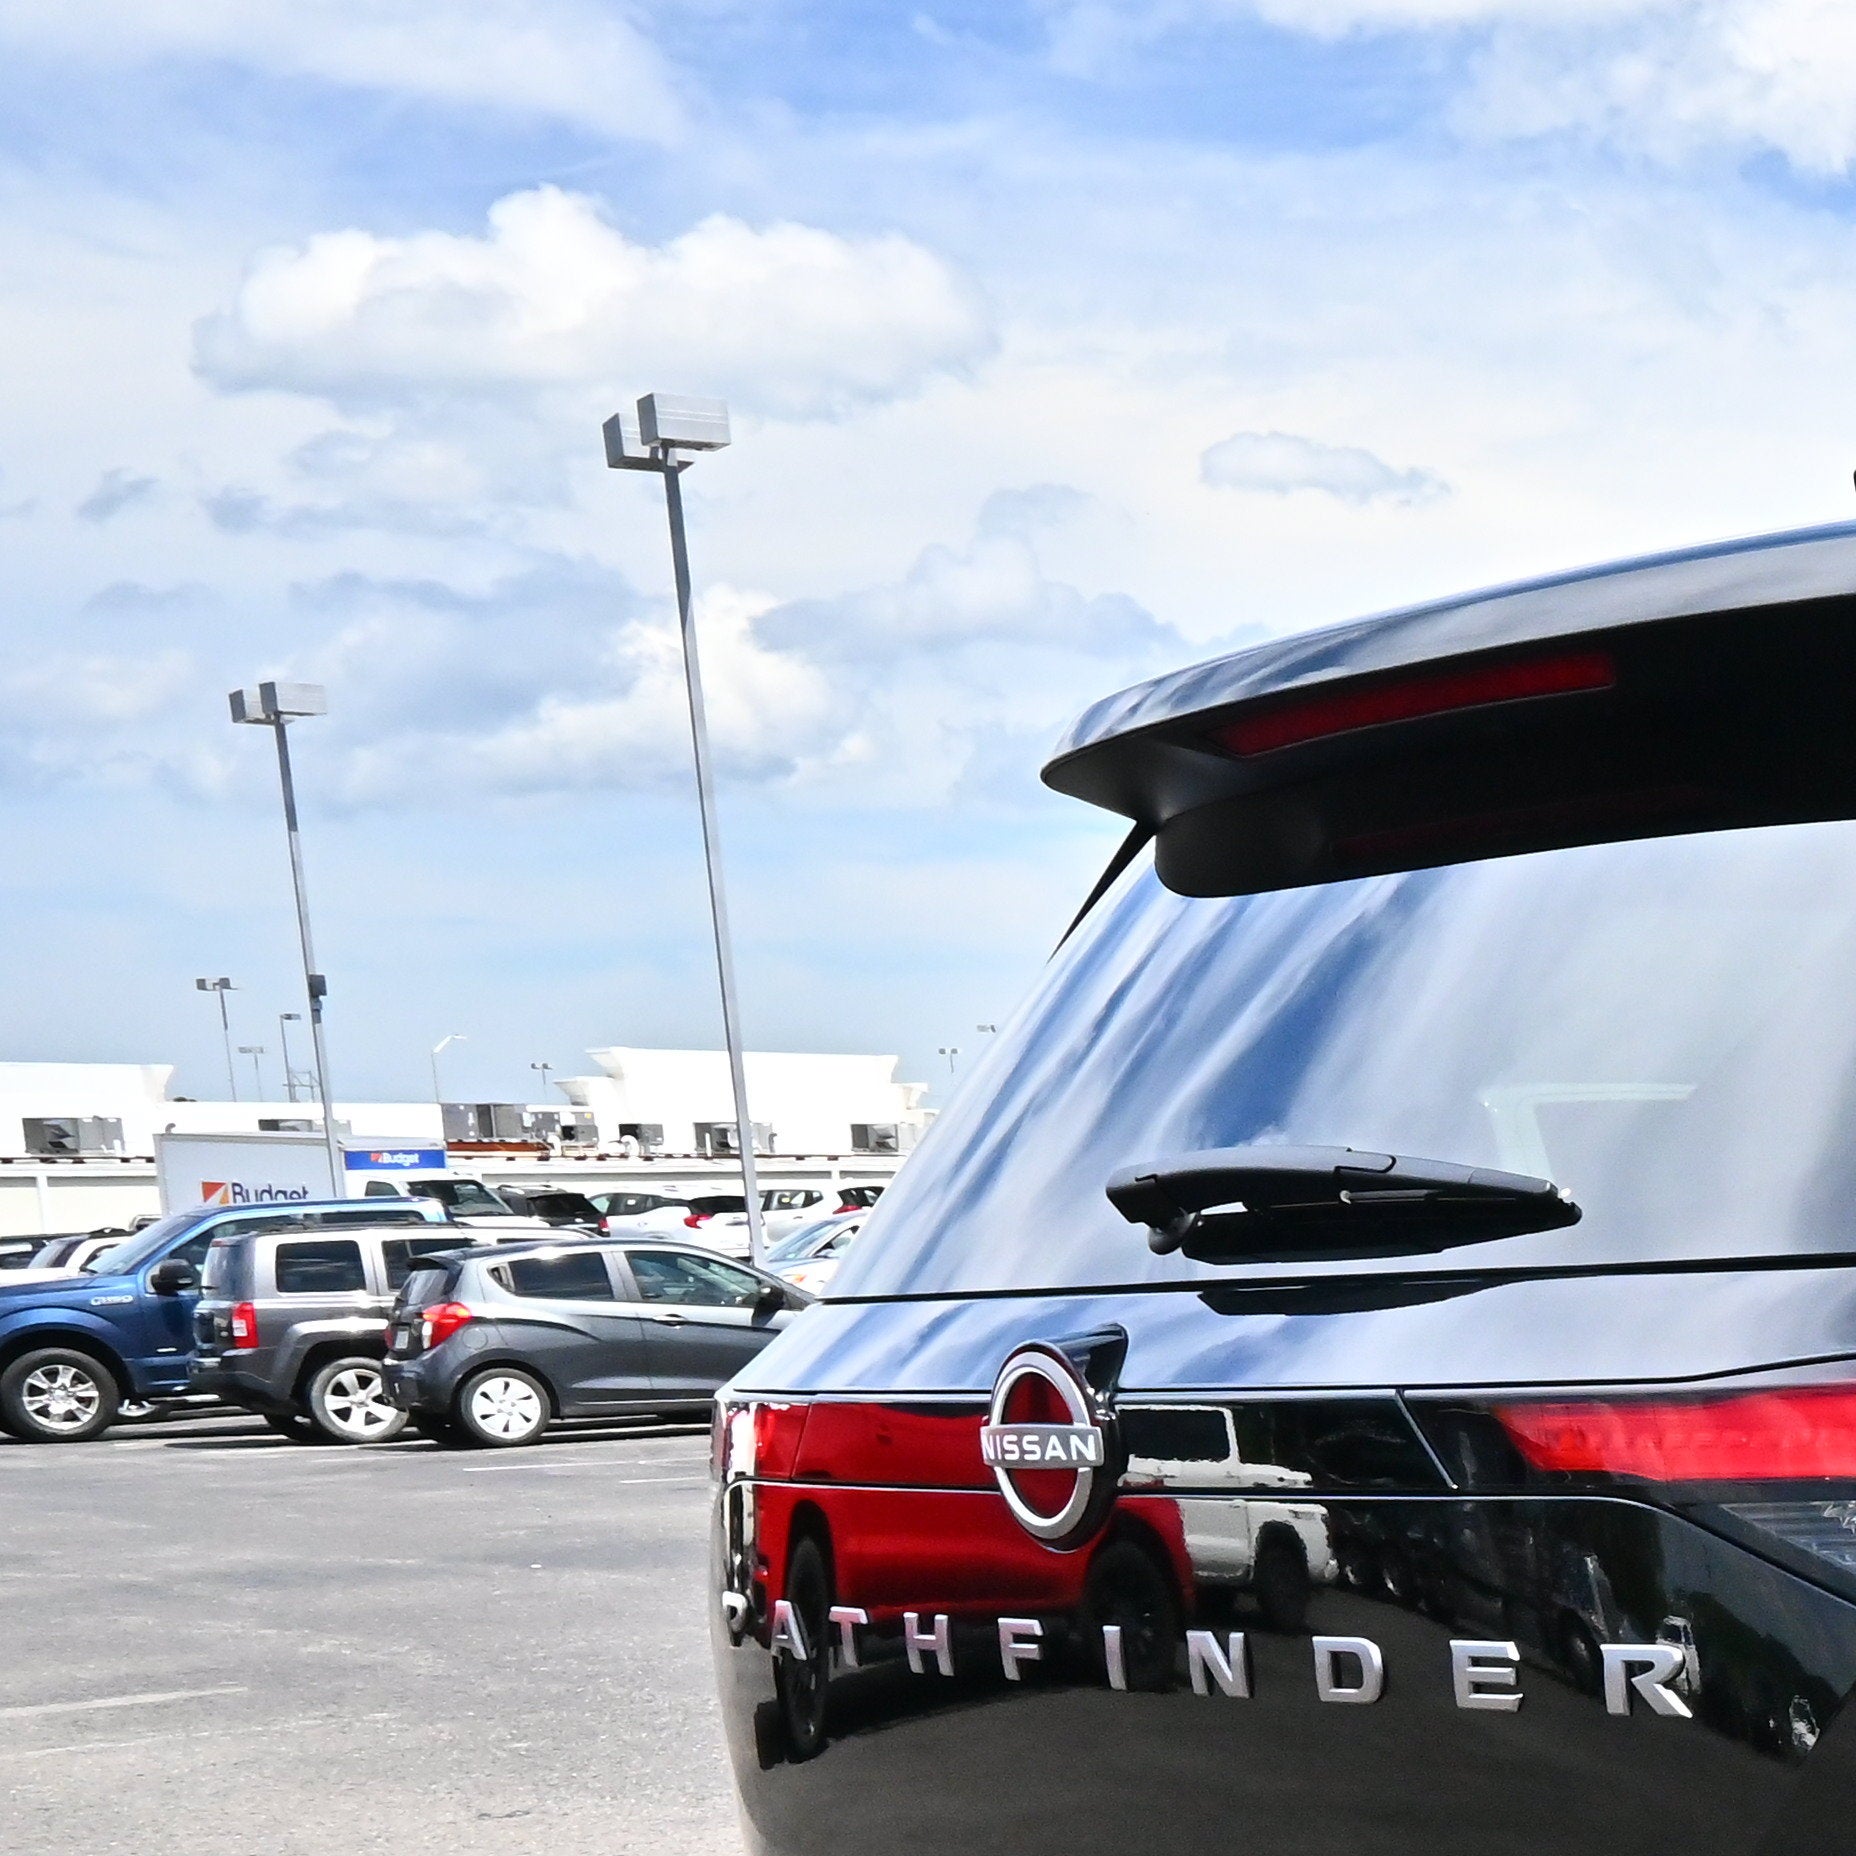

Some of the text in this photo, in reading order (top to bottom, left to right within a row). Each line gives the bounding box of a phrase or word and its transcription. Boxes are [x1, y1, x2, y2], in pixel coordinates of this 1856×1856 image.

[382, 1152, 420, 1166] Budget
[981, 1433, 1097, 1461] NISSAN
[722, 1590, 1693, 1720] PATHFINDER
